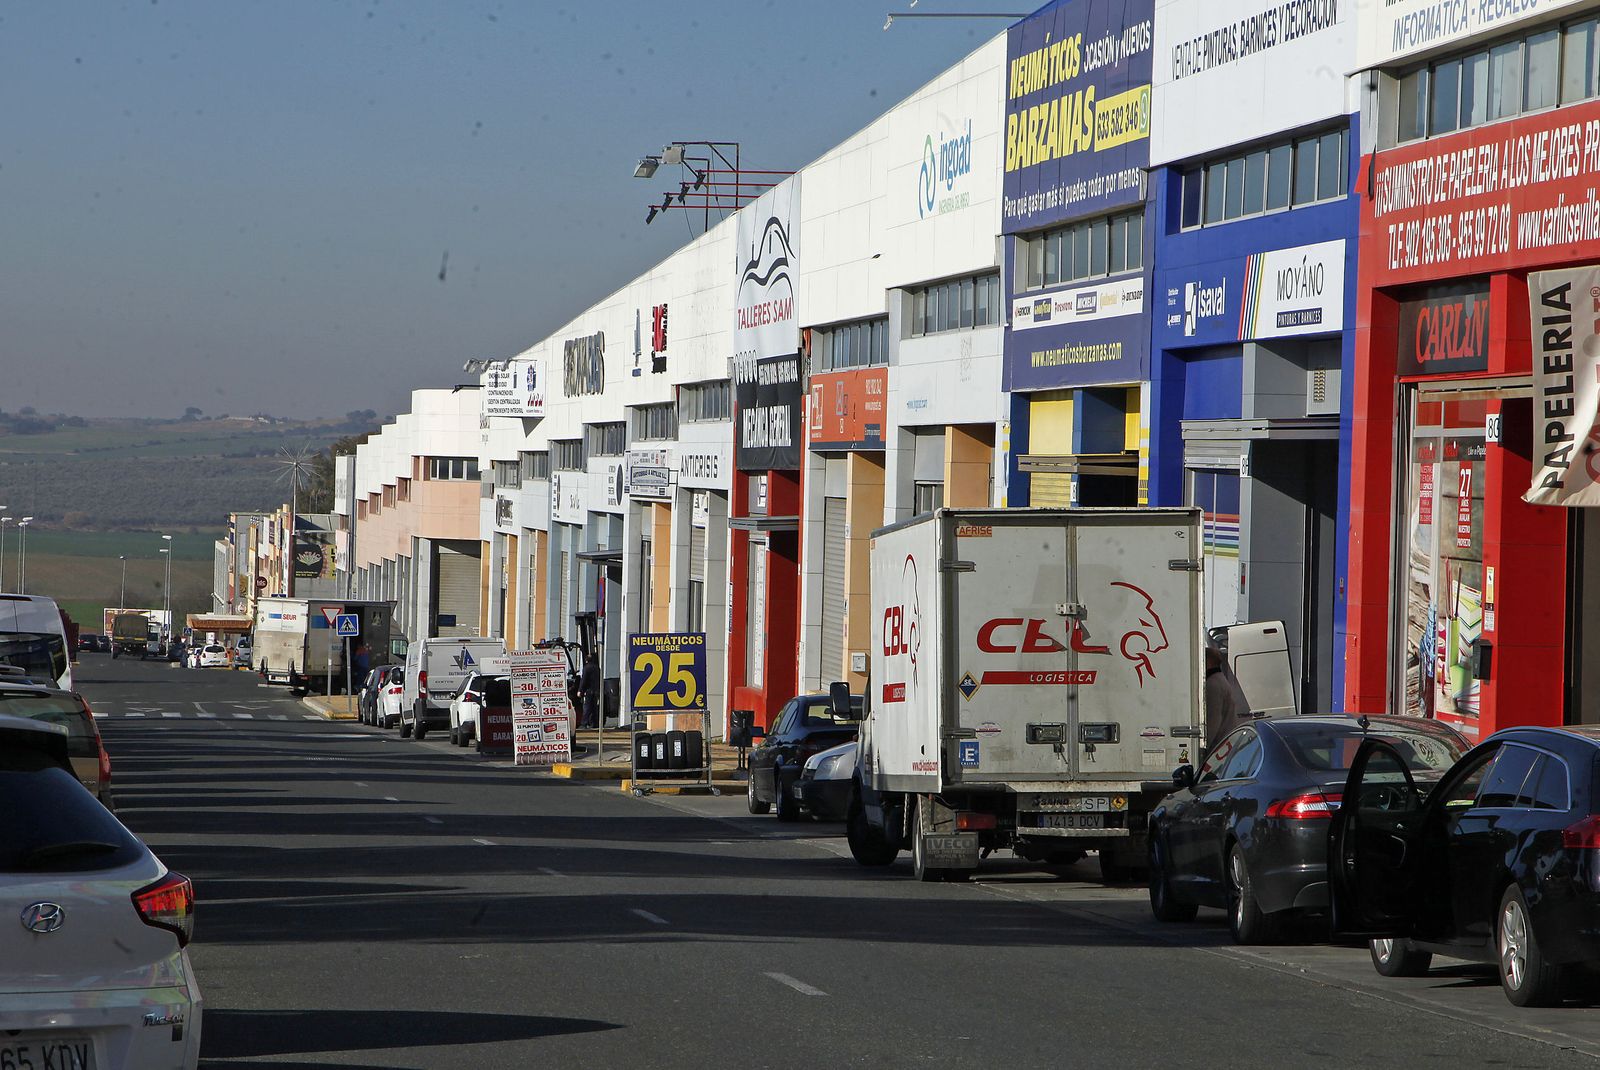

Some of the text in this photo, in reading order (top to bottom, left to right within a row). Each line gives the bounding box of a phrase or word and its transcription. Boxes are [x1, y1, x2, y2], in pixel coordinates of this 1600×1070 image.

[1172, 41, 1192, 80] VENTA
[1192, 37, 1202, 74] DE
[1202, 23, 1238, 66] PINTURAS,
[1240, 8, 1277, 58] BARNICES
[1278, 3, 1284, 44] Y
[1010, 32, 1082, 100] NEUMÁTICOS
[1084, 30, 1115, 72] OCASIÓN
[1120, 20, 1151, 58] NUEVOS
[1006, 84, 1096, 172] BARZANAS
[1097, 100, 1138, 141] 633 582 346
[940, 118, 972, 191] ingoad
[1434, 153, 1448, 202] DE
[1448, 142, 1498, 200] PAPELERIA
[1500, 140, 1509, 190] A
[1509, 135, 1530, 188] LOS
[1531, 124, 1581, 184] MEJORES
[1004, 166, 1140, 220] Para qué gastar más si puedes rodar por menos
[1404, 220, 1420, 268] 902
[1422, 217, 1436, 266] 195
[1436, 214, 1452, 262] 305
[1458, 210, 1472, 260] 955
[1474, 207, 1486, 257] 99
[1486, 204, 1498, 254] 72
[1499, 202, 1510, 253] 03
[738, 297, 792, 330] TALLERES SAM
[1198, 277, 1226, 318] isaval
[1278, 314, 1296, 327] PINTURAS
[1300, 310, 1322, 324] BARNICES
[1540, 282, 1574, 488] PAPELERIA
[680, 454, 718, 478] ANTICRISIS
[1460, 468, 1472, 497] 27
[632, 634, 703, 646] NEUMÁTICOS
[884, 604, 908, 656] CBL
[976, 618, 1112, 655] CBL
[542, 680, 552, 688] 20
[1030, 674, 1094, 683] LOGISTICA
[516, 734, 526, 742] 20
[518, 743, 568, 752] NEUMÁTICOS
[965, 748, 975, 762] E
[1048, 816, 1100, 826] 1413 DCV
[928, 838, 974, 848] IVECO
